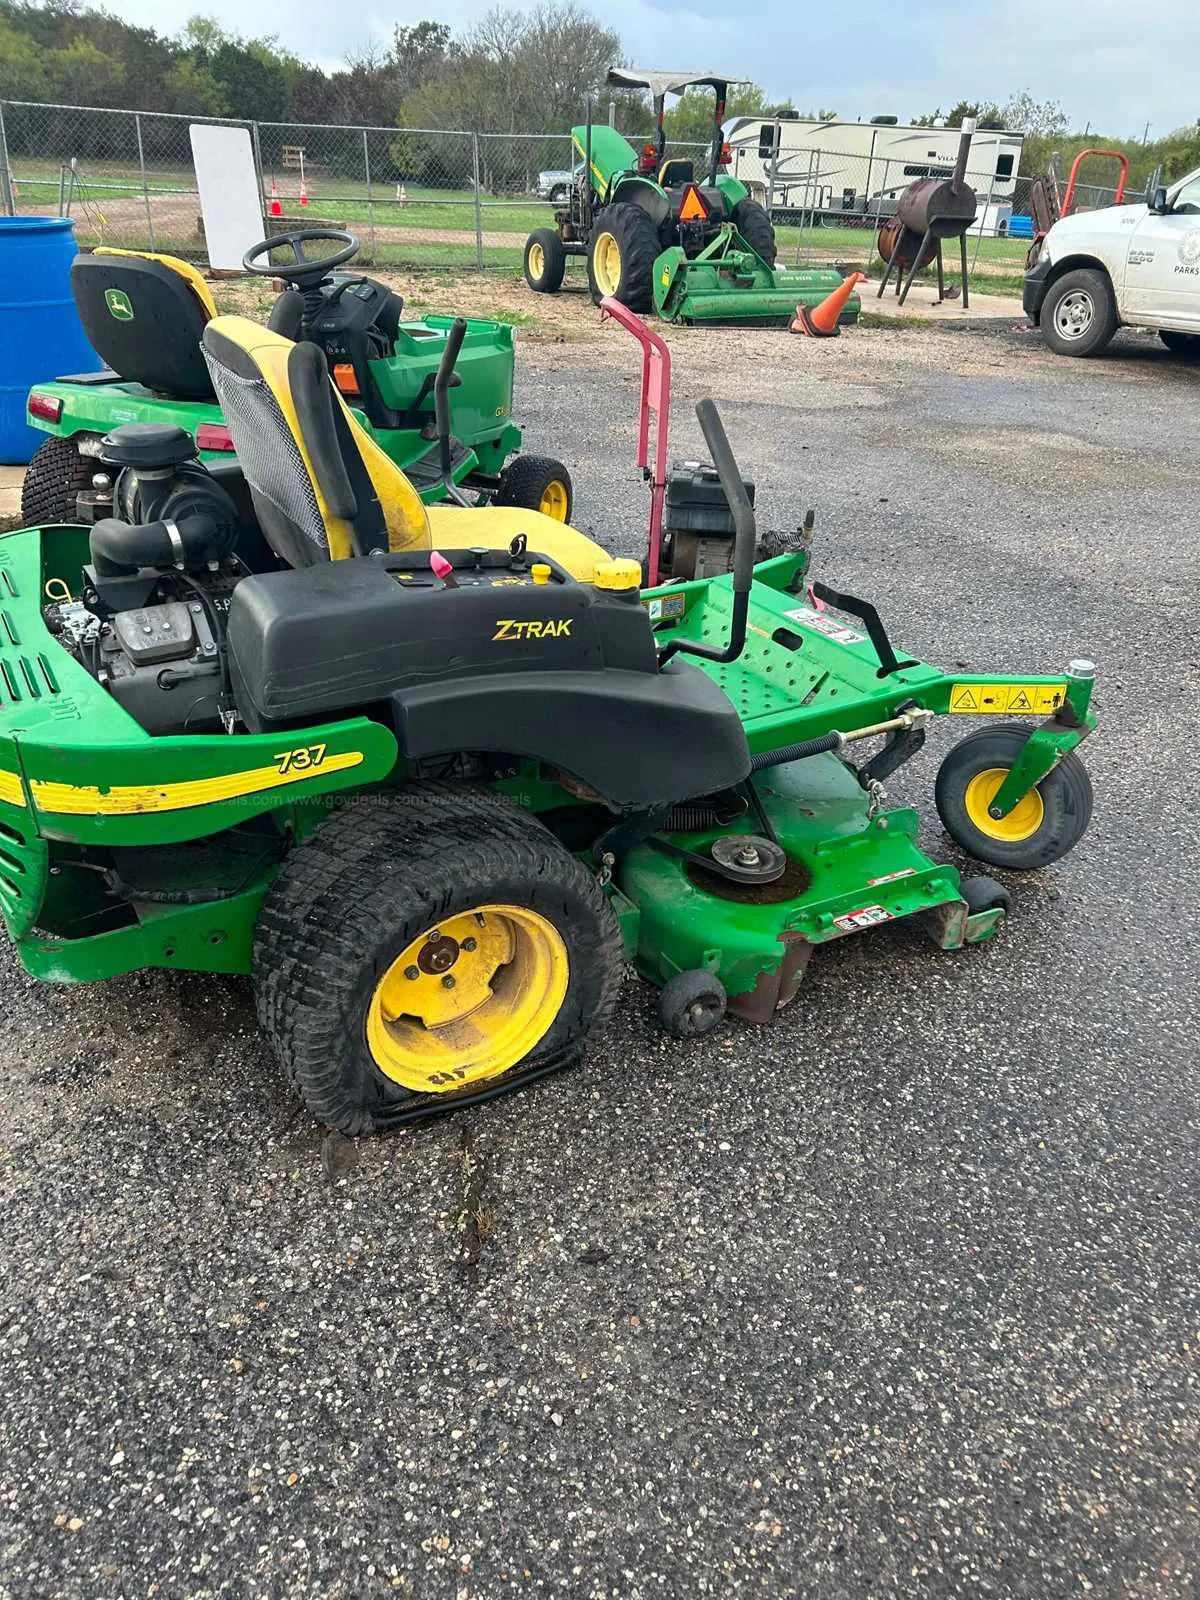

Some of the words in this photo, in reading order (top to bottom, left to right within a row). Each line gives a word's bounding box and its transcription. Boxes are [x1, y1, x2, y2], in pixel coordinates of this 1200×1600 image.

[1174, 265, 1200, 275] PARKS
[491, 618, 574, 641] ZTRAK
[273, 743, 327, 774] 737
